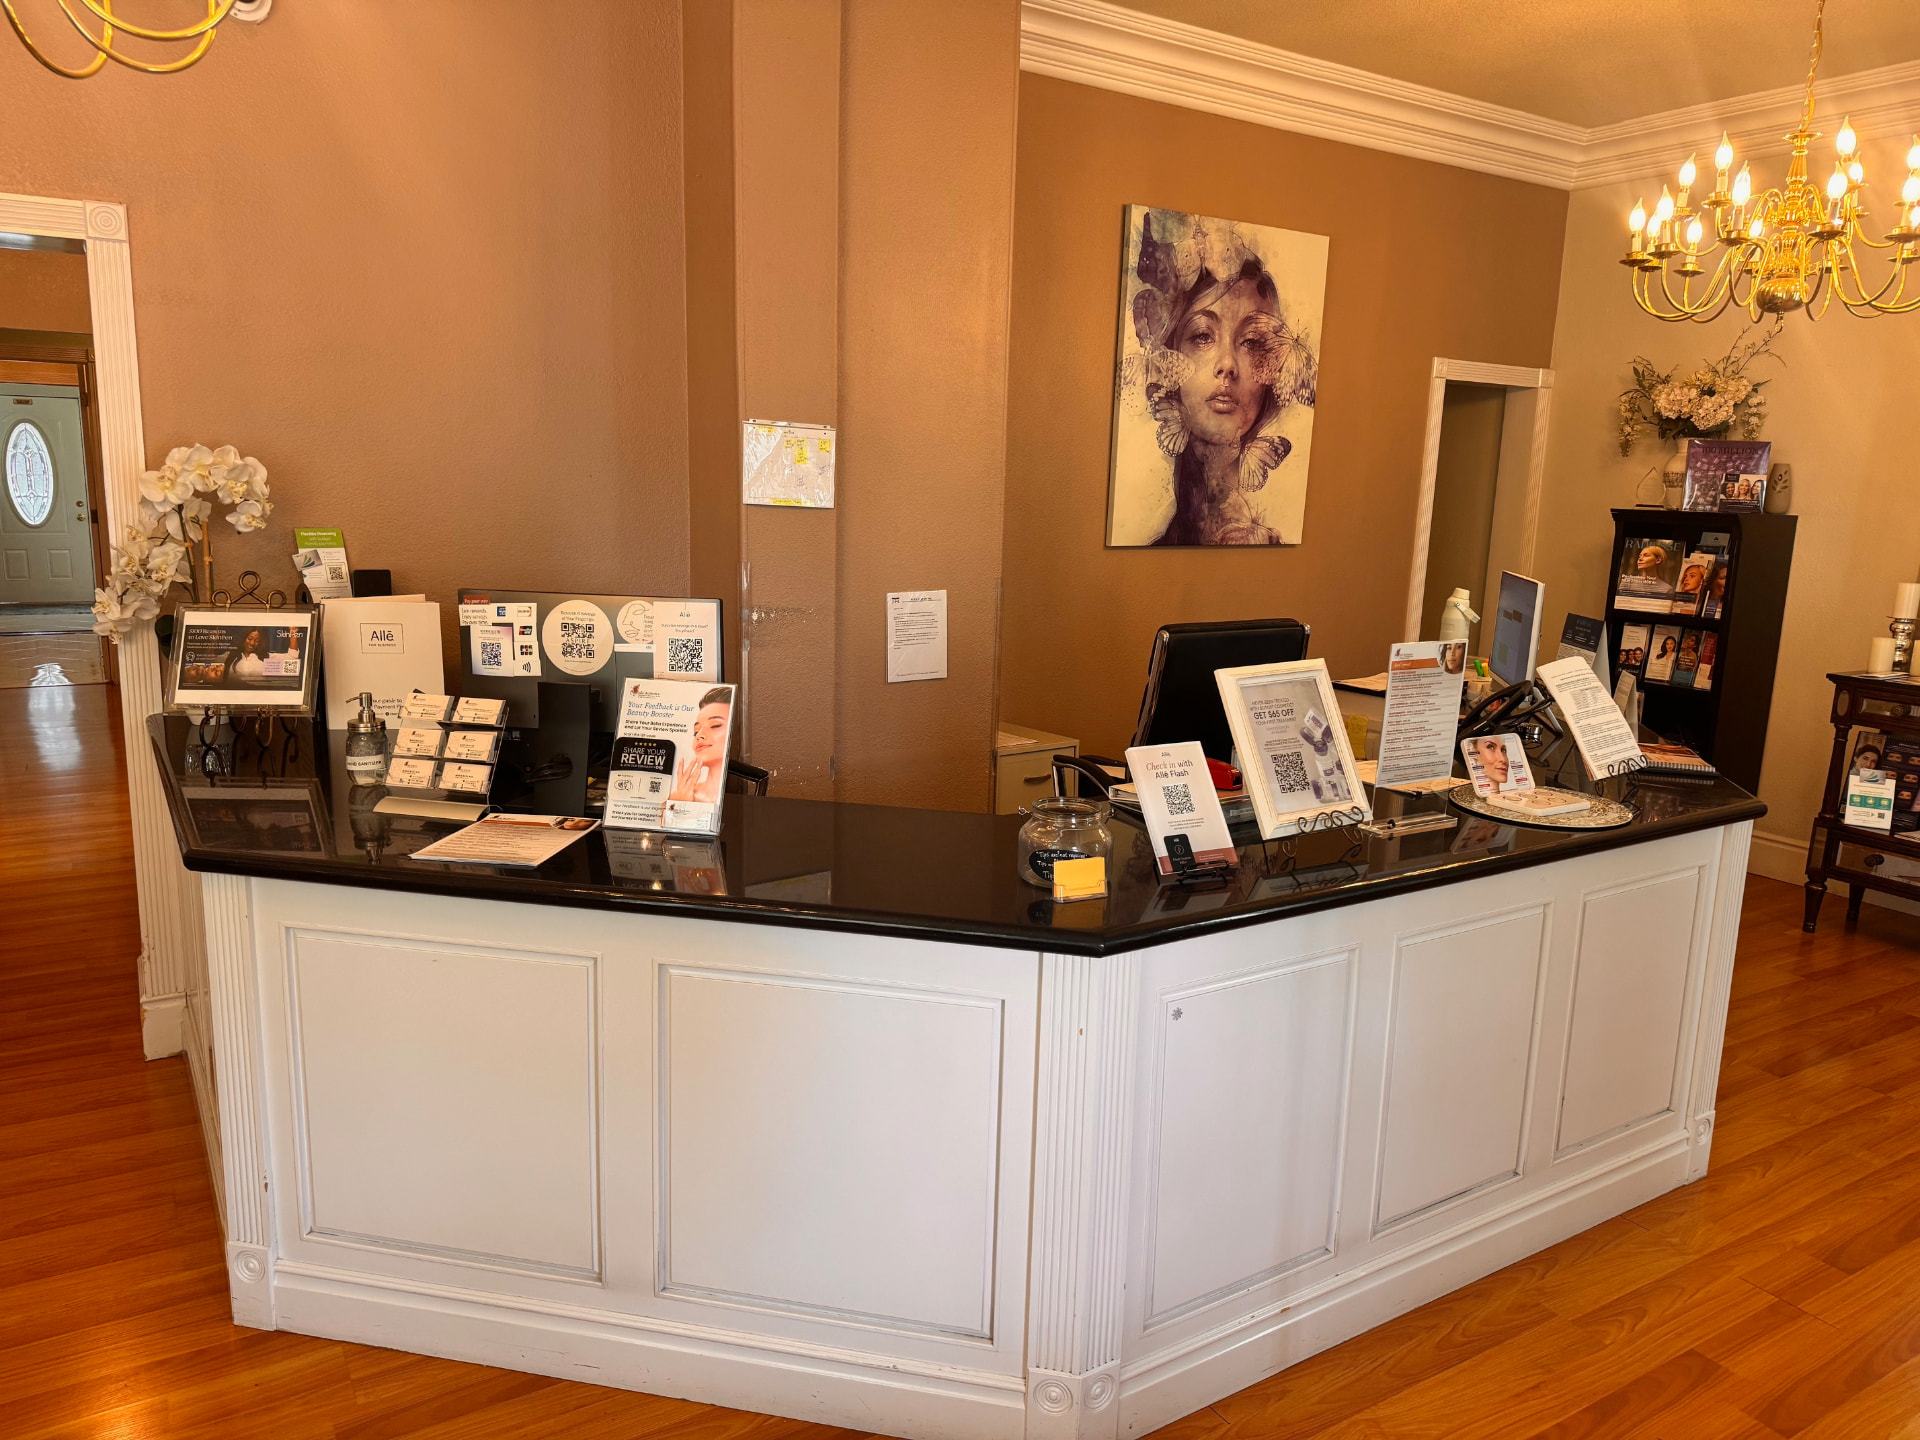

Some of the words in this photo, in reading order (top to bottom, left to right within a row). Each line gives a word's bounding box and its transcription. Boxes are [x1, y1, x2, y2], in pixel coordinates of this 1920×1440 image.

[1719, 447, 1759, 455] MILLION
[276, 629, 304, 638] SkinPen
[644, 702, 674, 710] Feedback
[674, 703, 680, 711] is
[626, 708, 650, 717] Beauty
[650, 710, 674, 718] Booster
[1253, 712, 1267, 720] GET
[1268, 710, 1280, 718] $65
[1281, 708, 1294, 717] OFF
[623, 746, 646, 754] SHARE
[646, 748, 666, 756] YOUR
[620, 753, 666, 766] REVIEW
[1145, 761, 1168, 771] Check
[1169, 761, 1177, 769] in
[1178, 760, 1194, 768] with
[1170, 769, 1189, 778] Flash
